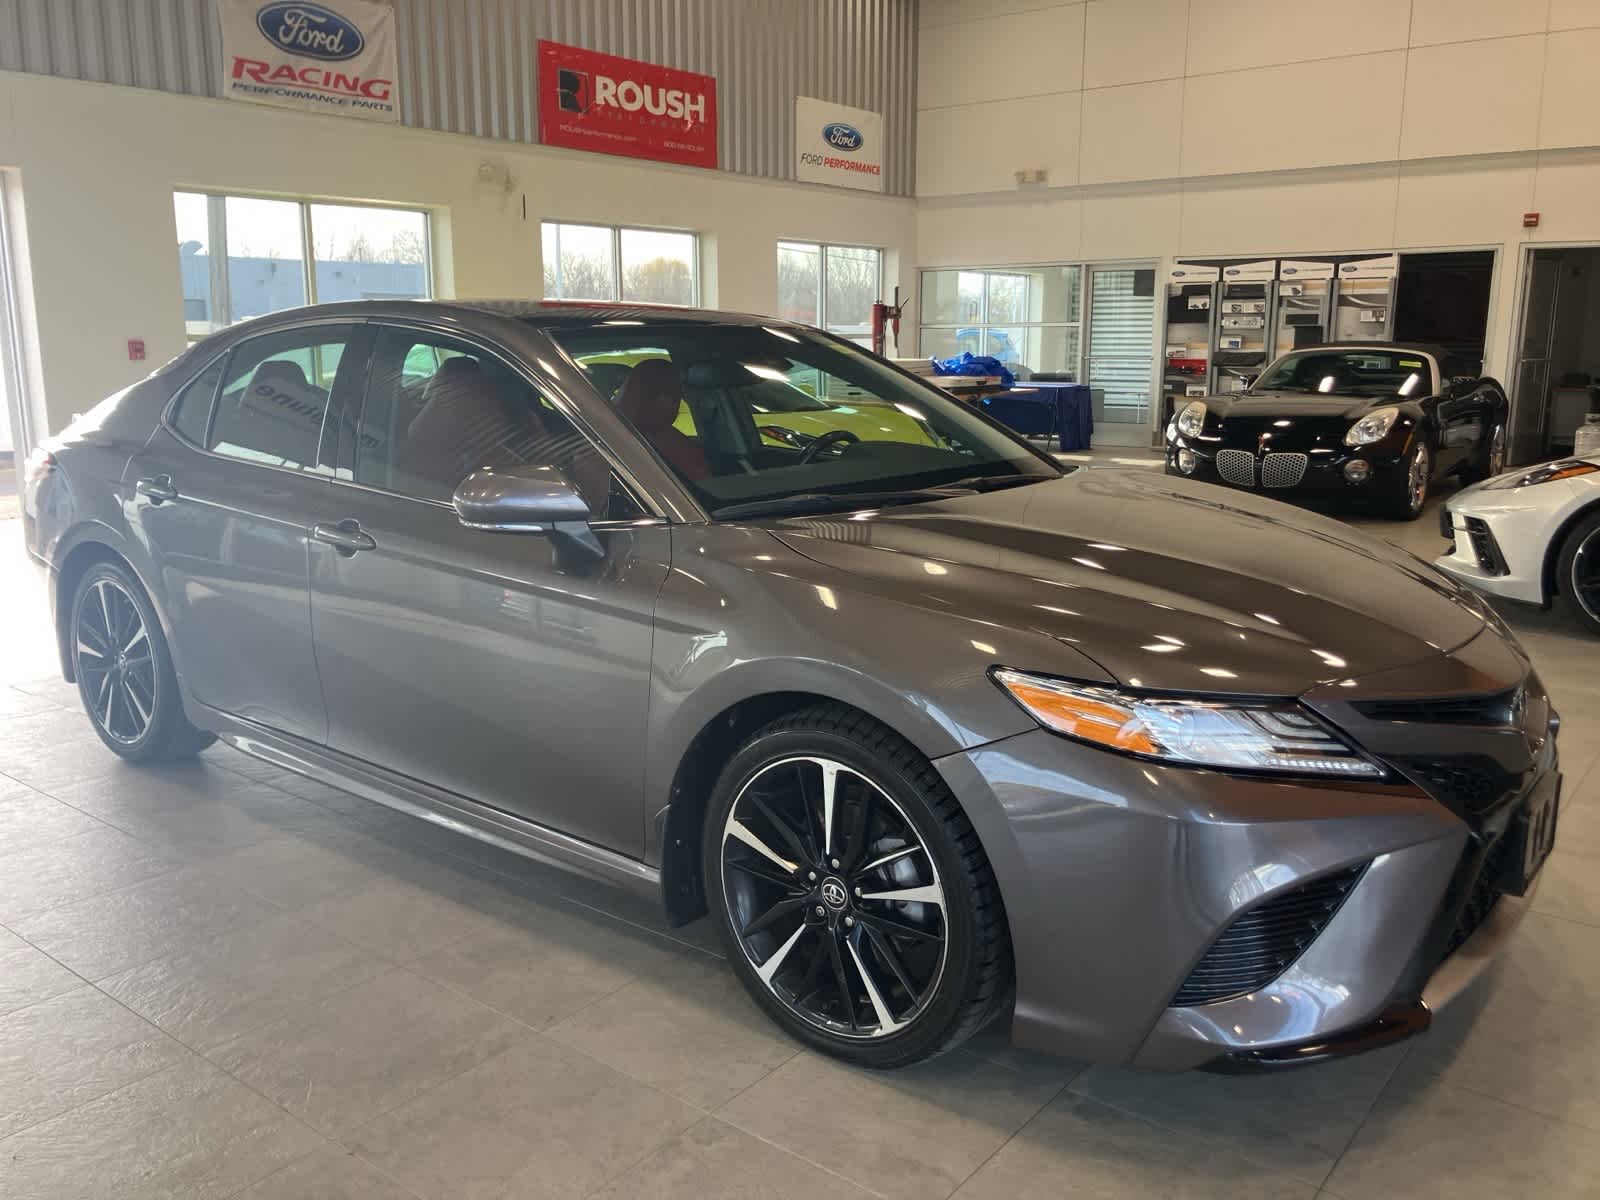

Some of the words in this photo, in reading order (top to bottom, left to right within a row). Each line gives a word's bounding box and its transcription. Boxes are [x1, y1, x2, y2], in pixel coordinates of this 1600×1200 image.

[278, 8, 345, 54] Ford
[231, 56, 393, 101] RACING
[232, 82, 348, 106] PERFORMANCE
[351, 99, 393, 112] PARTS
[595, 75, 705, 123] ROUSH
[830, 126, 856, 147] Ford
[800, 153, 823, 166] FORD
[823, 156, 881, 176] PERFORMANCE
